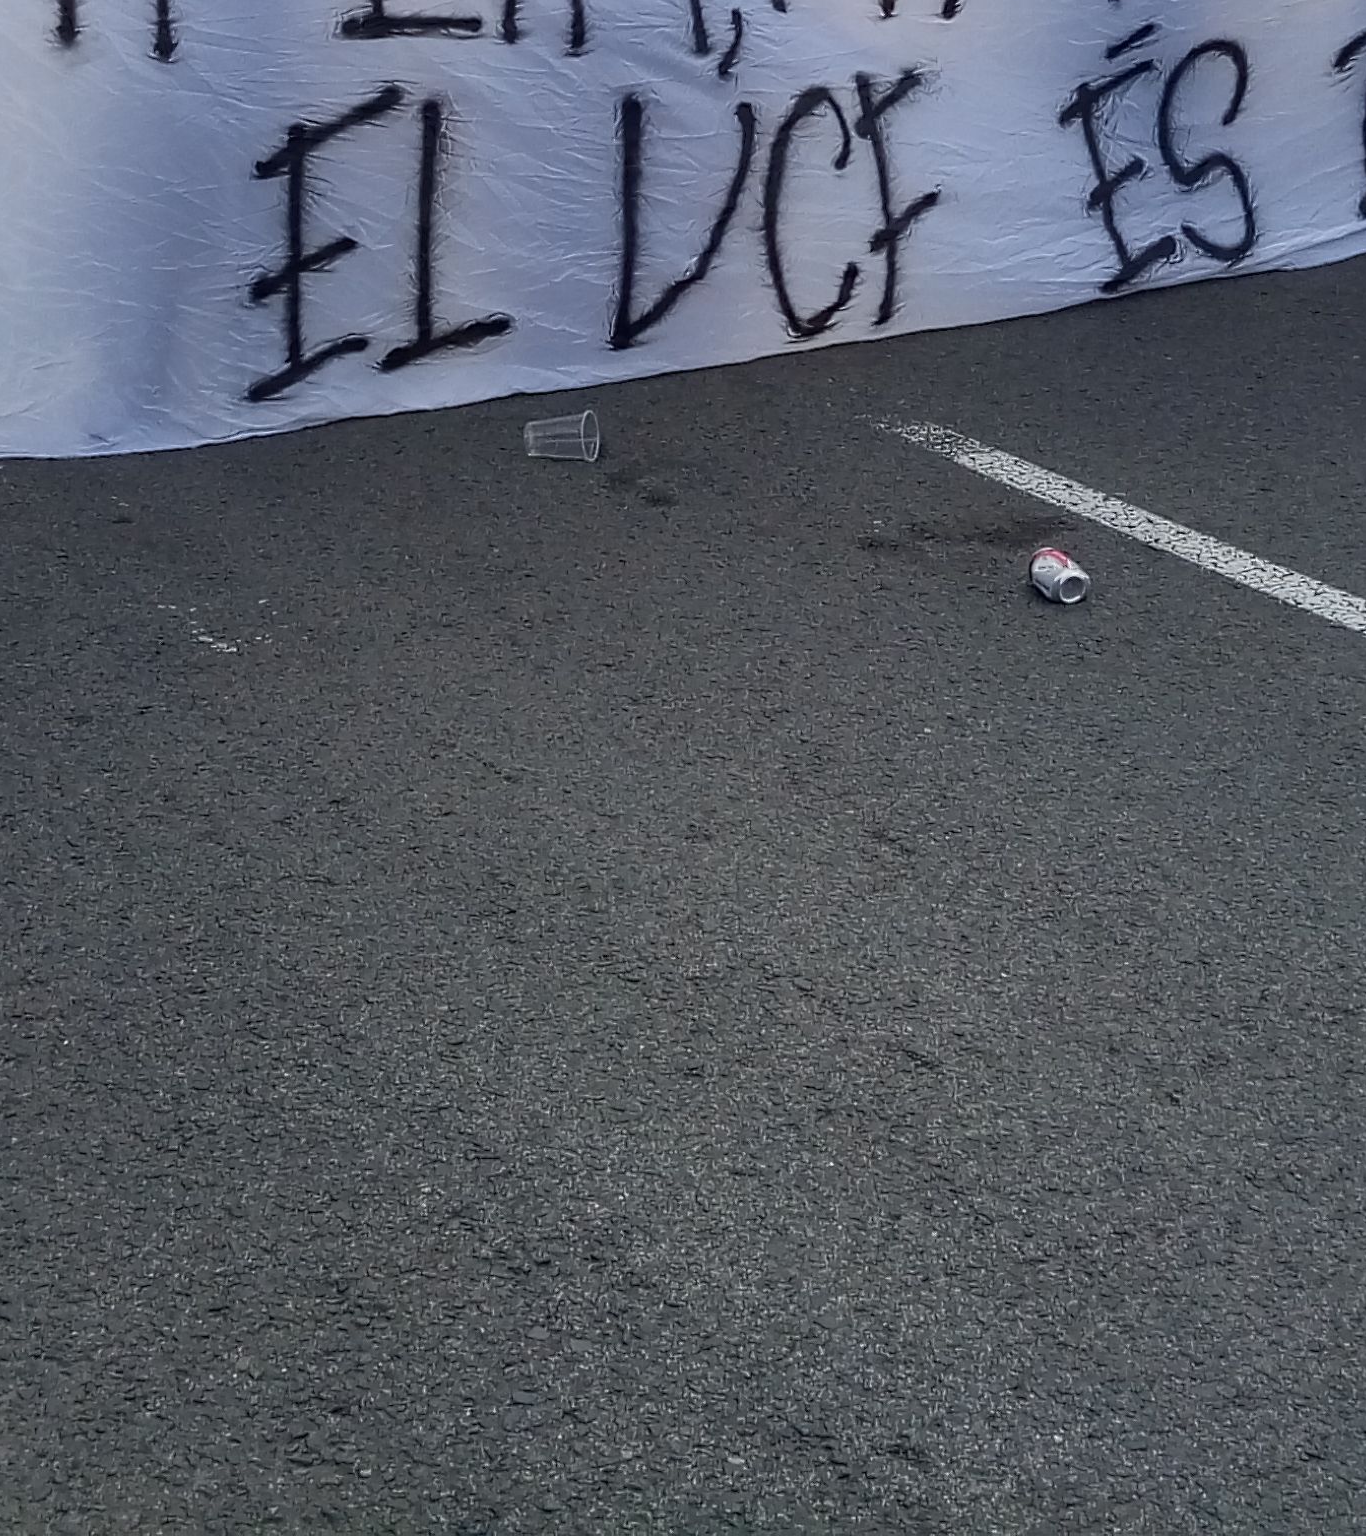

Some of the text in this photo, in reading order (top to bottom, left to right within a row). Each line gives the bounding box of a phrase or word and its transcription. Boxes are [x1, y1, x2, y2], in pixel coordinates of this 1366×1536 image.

[245, 82, 514, 402] EL
[609, 68, 940, 350] VCF
[1059, 23, 1257, 292] ÉS
